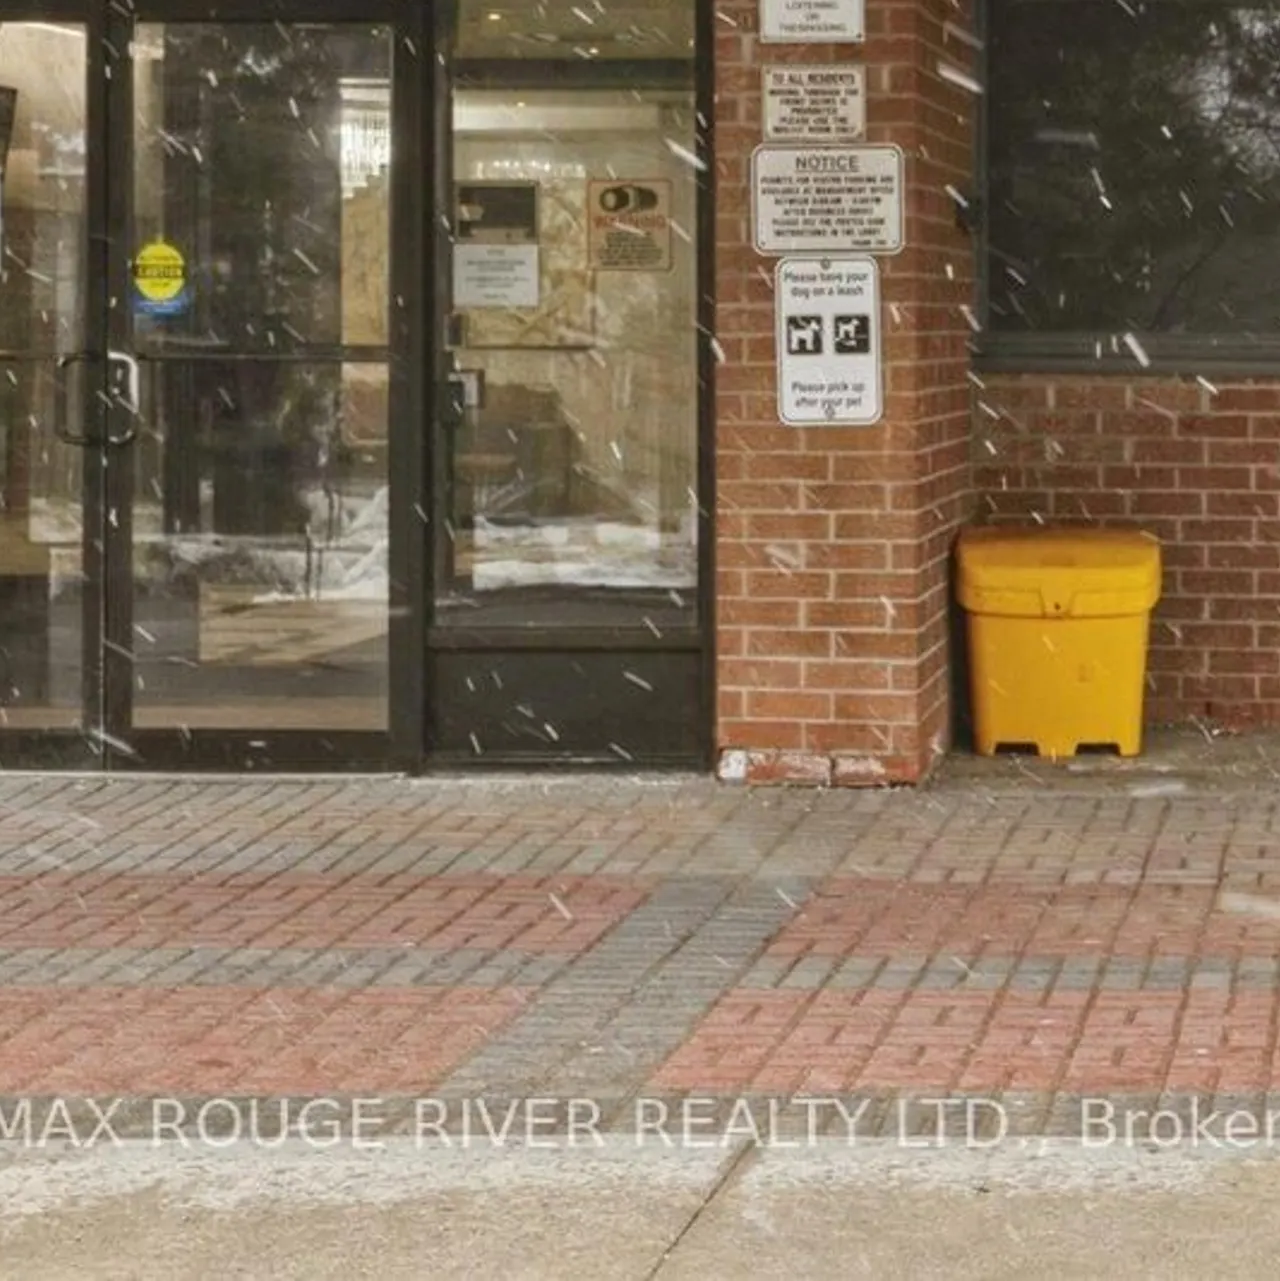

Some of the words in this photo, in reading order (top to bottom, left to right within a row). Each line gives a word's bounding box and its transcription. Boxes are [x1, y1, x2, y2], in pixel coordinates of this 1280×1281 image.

[788, 72, 804, 87] ALL
[795, 155, 859, 170] NOTICE
[784, 271, 818, 282] Please
[790, 286, 810, 300] dog
[791, 381, 825, 393] Please
[827, 381, 849, 395] pick
